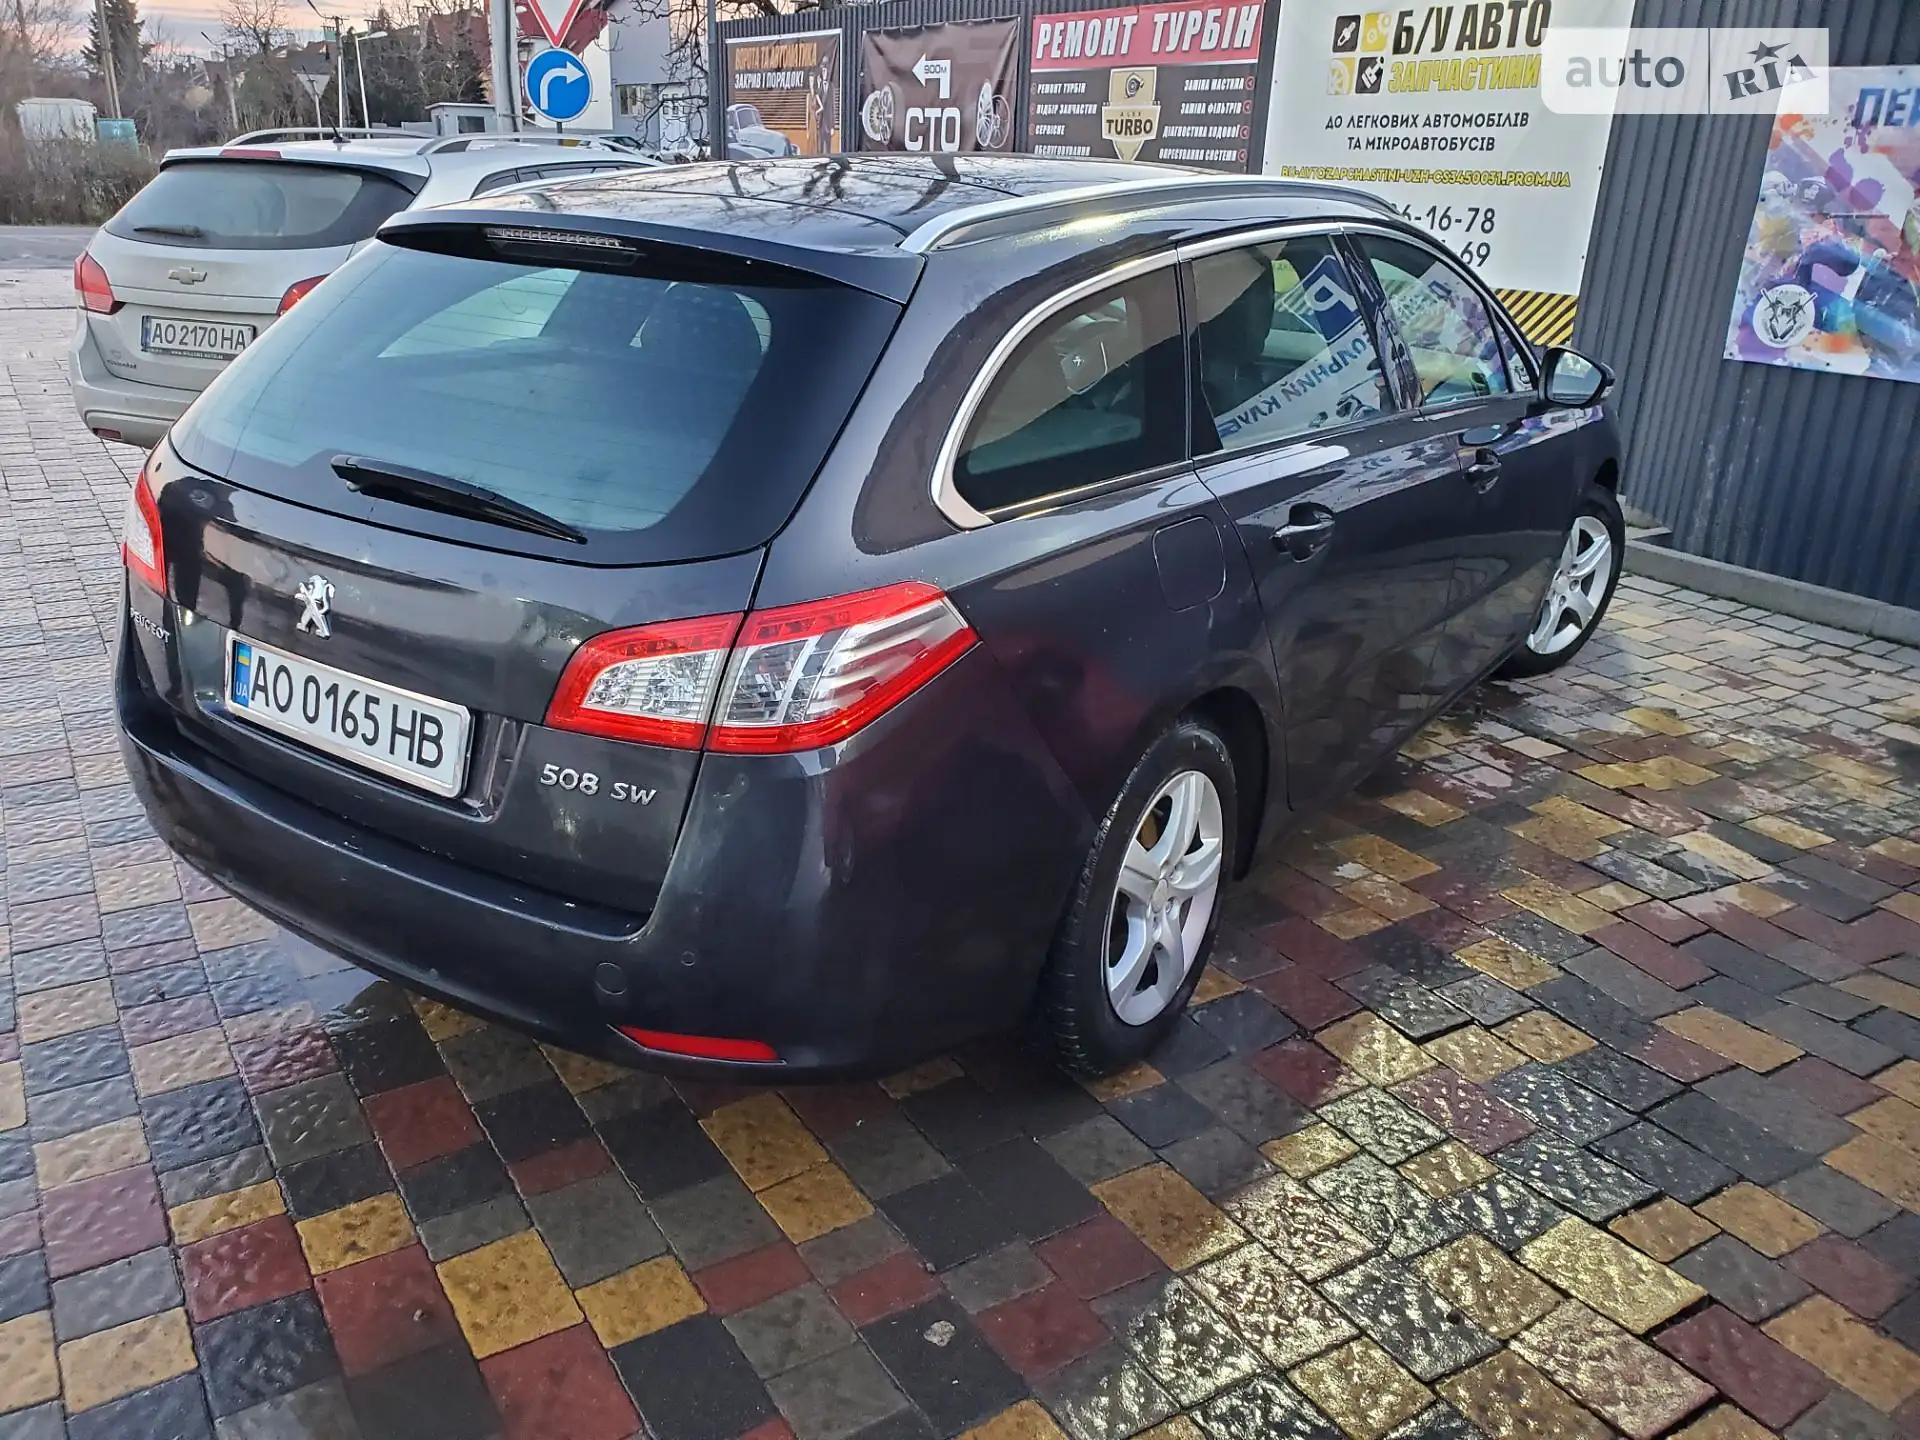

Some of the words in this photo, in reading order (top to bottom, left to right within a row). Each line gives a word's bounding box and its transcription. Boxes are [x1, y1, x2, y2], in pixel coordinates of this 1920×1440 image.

[1035, 15, 1138, 59] РЕМОНТ
[1151, 4, 1260, 53] ТУРБІН
[1392, 6, 1454, 55] Б/У
[1454, 0, 1551, 51] АВТО
[735, 72, 761, 89] ЗАКРИВ
[767, 70, 804, 90] ПОРЯДОК!
[1387, 54, 1542, 93] ЗАПЧАСТИНИ
[1037, 83, 1062, 95] РЕМОНТ
[1063, 82, 1087, 94] ТУРБІН
[1183, 79, 1210, 91] ЗАМІНА
[1180, 102, 1207, 115] ЗАМІНА
[1207, 102, 1242, 114] ФІЛЬТРІВ
[904, 107, 960, 152] СТО
[1106, 118, 1153, 136] TURBO
[1325, 116, 1343, 130] ДО
[1347, 113, 1420, 129] ЛЕГКОВИХ
[1422, 112, 1529, 129] АВТОМОБІЛІВ
[1347, 136, 1362, 150] ТА
[1365, 136, 1496, 151] МІКРОАВТОБУСІВ
[151, 322, 176, 344] AO
[178, 325, 218, 347] 2170
[220, 327, 246, 351] HA
[235, 682, 249, 698] UA
[250, 655, 294, 714] AO
[302, 674, 380, 747] 0165
[388, 703, 445, 769] HB
[540, 763, 599, 795] 508
[610, 782, 657, 805] SW
